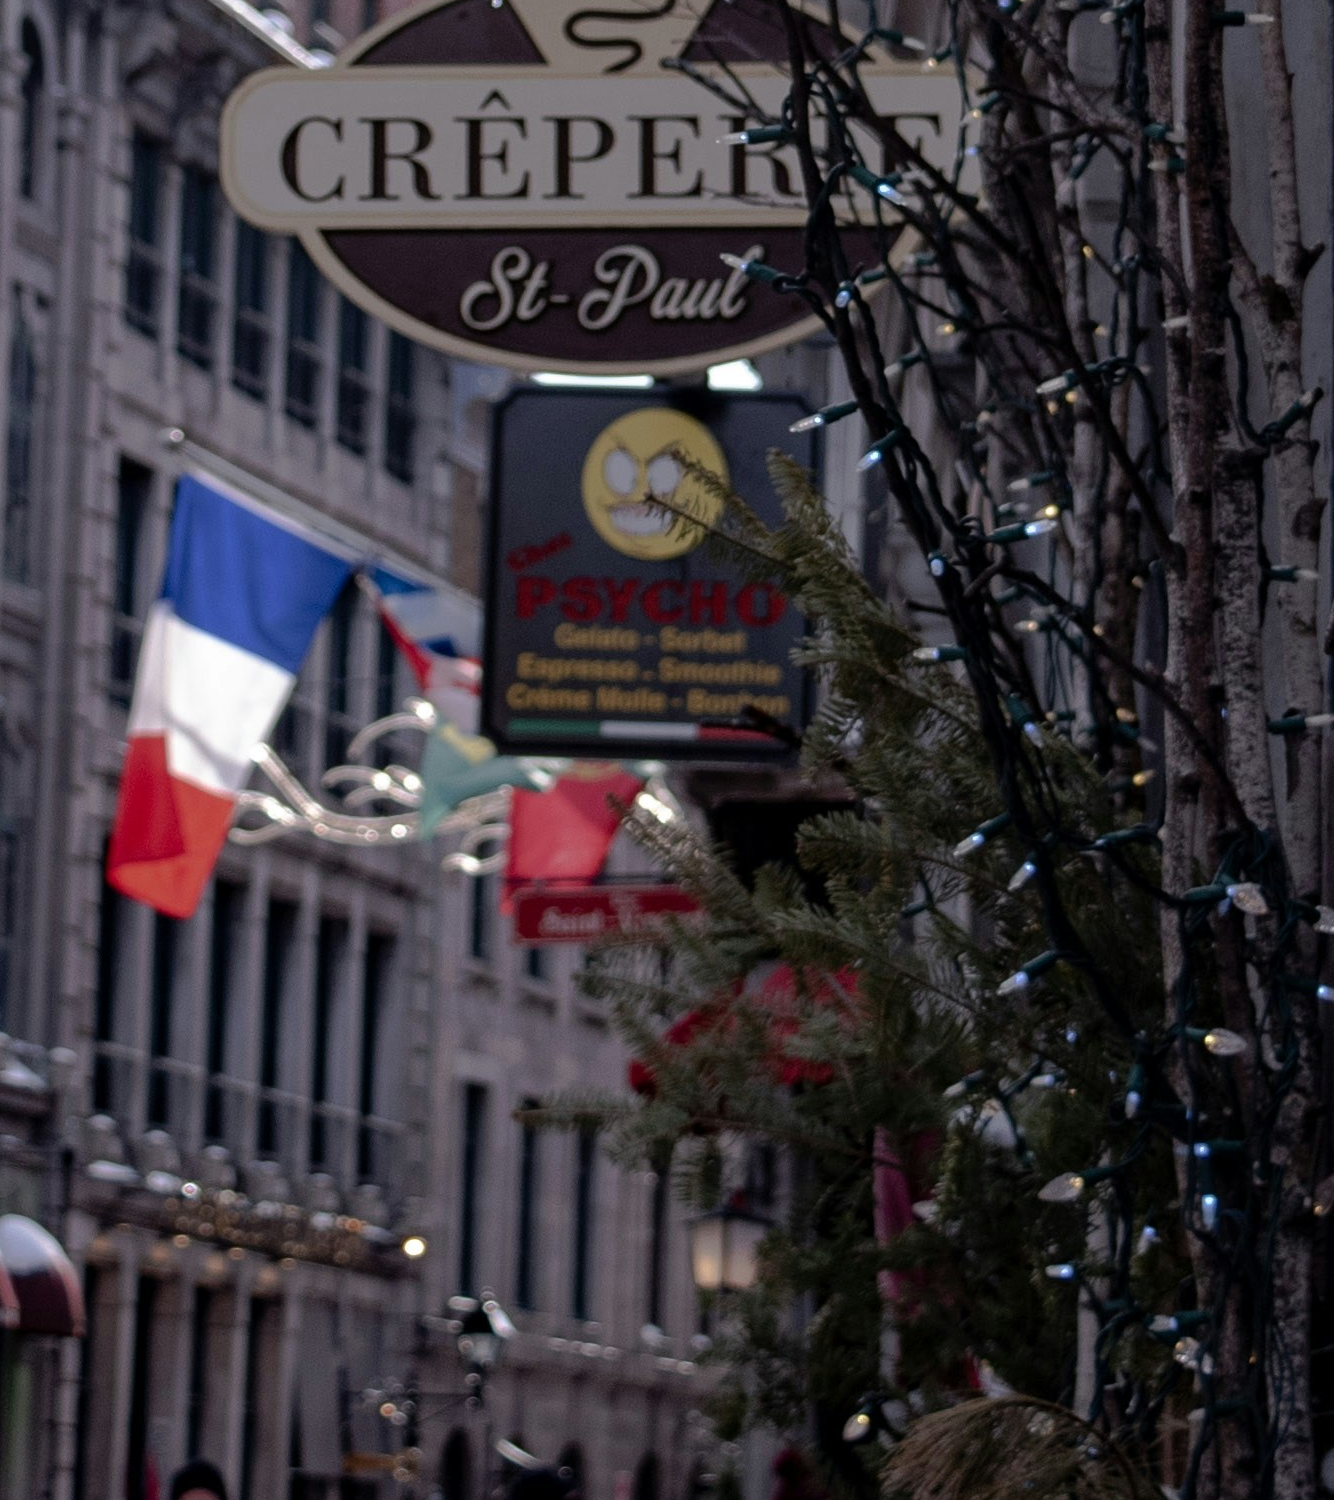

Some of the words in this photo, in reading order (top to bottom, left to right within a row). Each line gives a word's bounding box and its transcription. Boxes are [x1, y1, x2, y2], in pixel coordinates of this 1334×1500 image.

[460, 244, 764, 330] St-Paul
[517, 575, 787, 628] PSYCHO
[554, 622, 641, 650] Gelato
[660, 625, 747, 654] Sorbet
